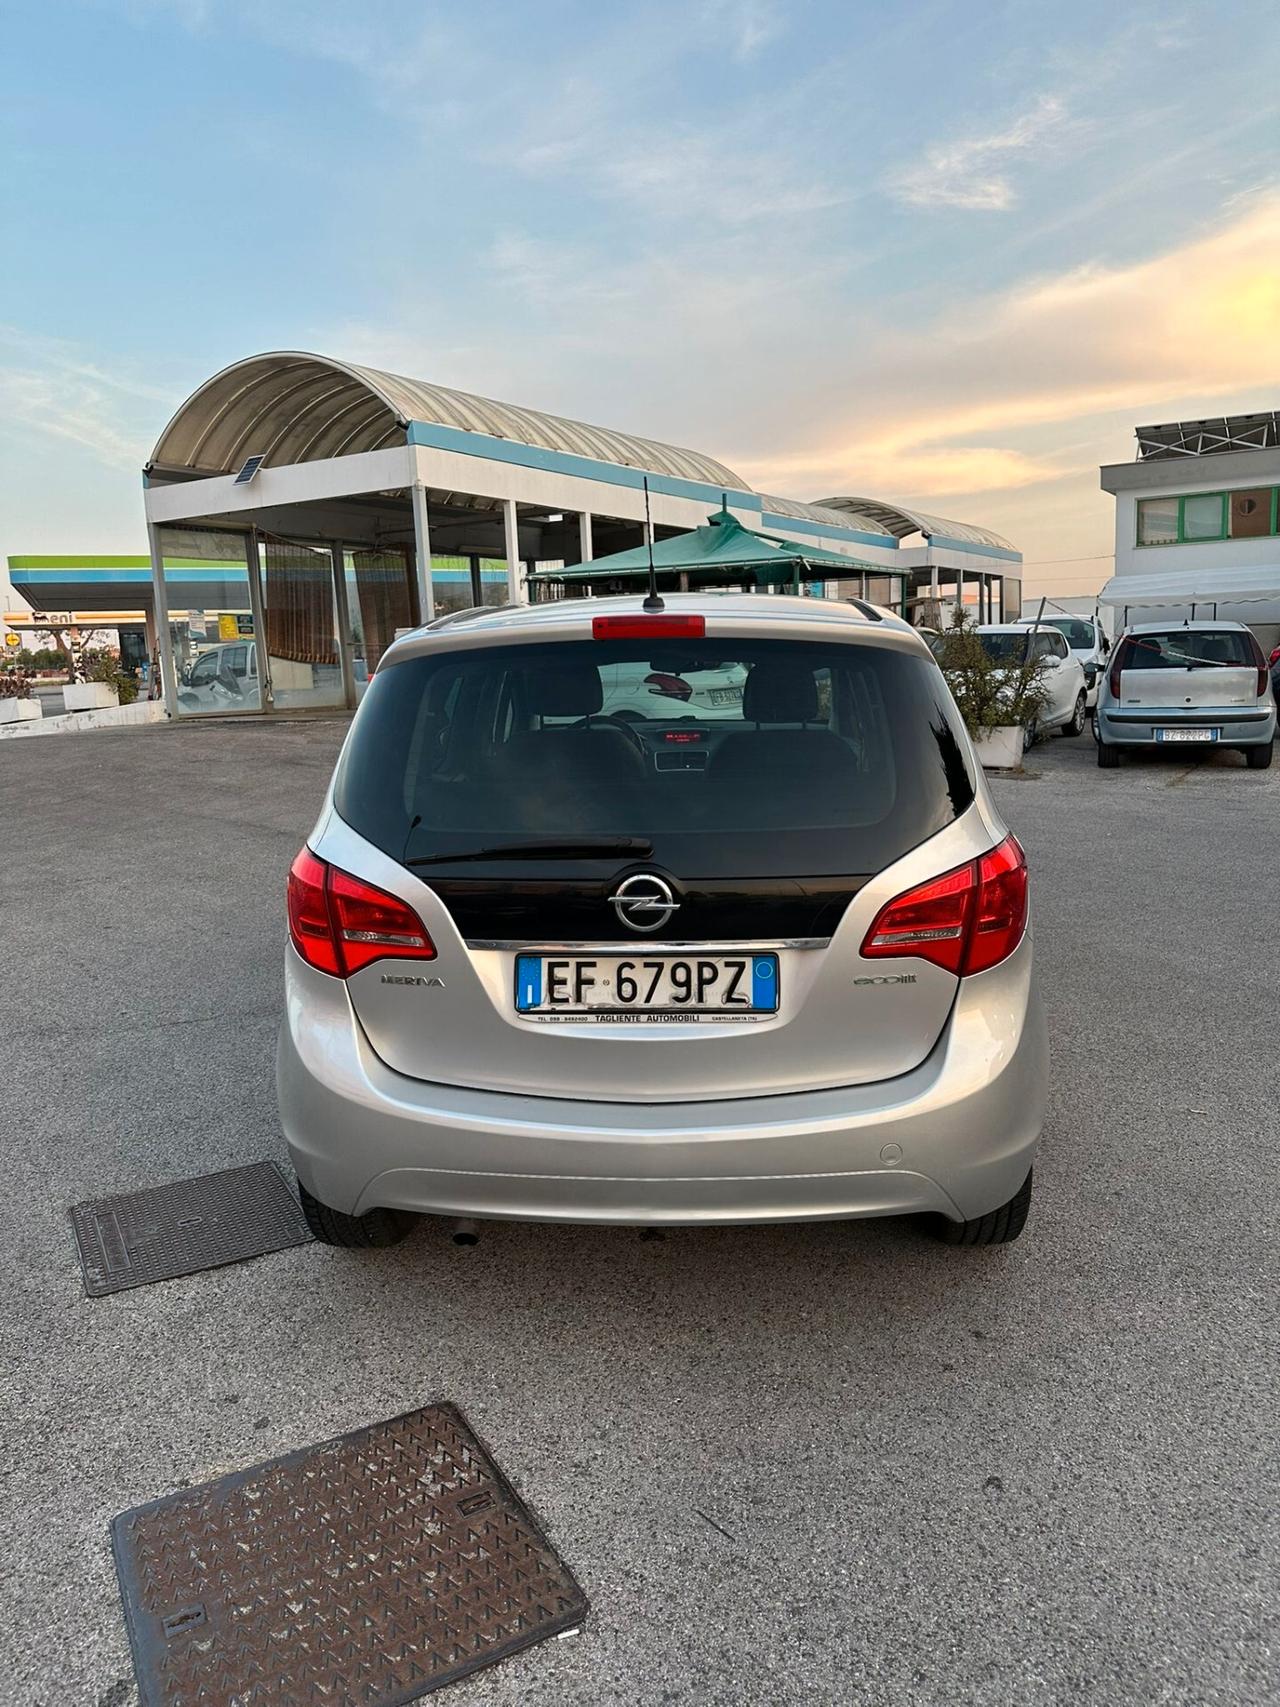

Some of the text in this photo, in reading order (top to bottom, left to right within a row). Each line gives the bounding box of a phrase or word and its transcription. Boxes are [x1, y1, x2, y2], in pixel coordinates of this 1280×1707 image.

[50, 612, 73, 623] eni
[381, 974, 446, 987] MERIVA
[547, 961, 597, 1004] EF
[616, 961, 747, 1004] 679PZ
[595, 1015, 641, 1023] TAGLIENTE
